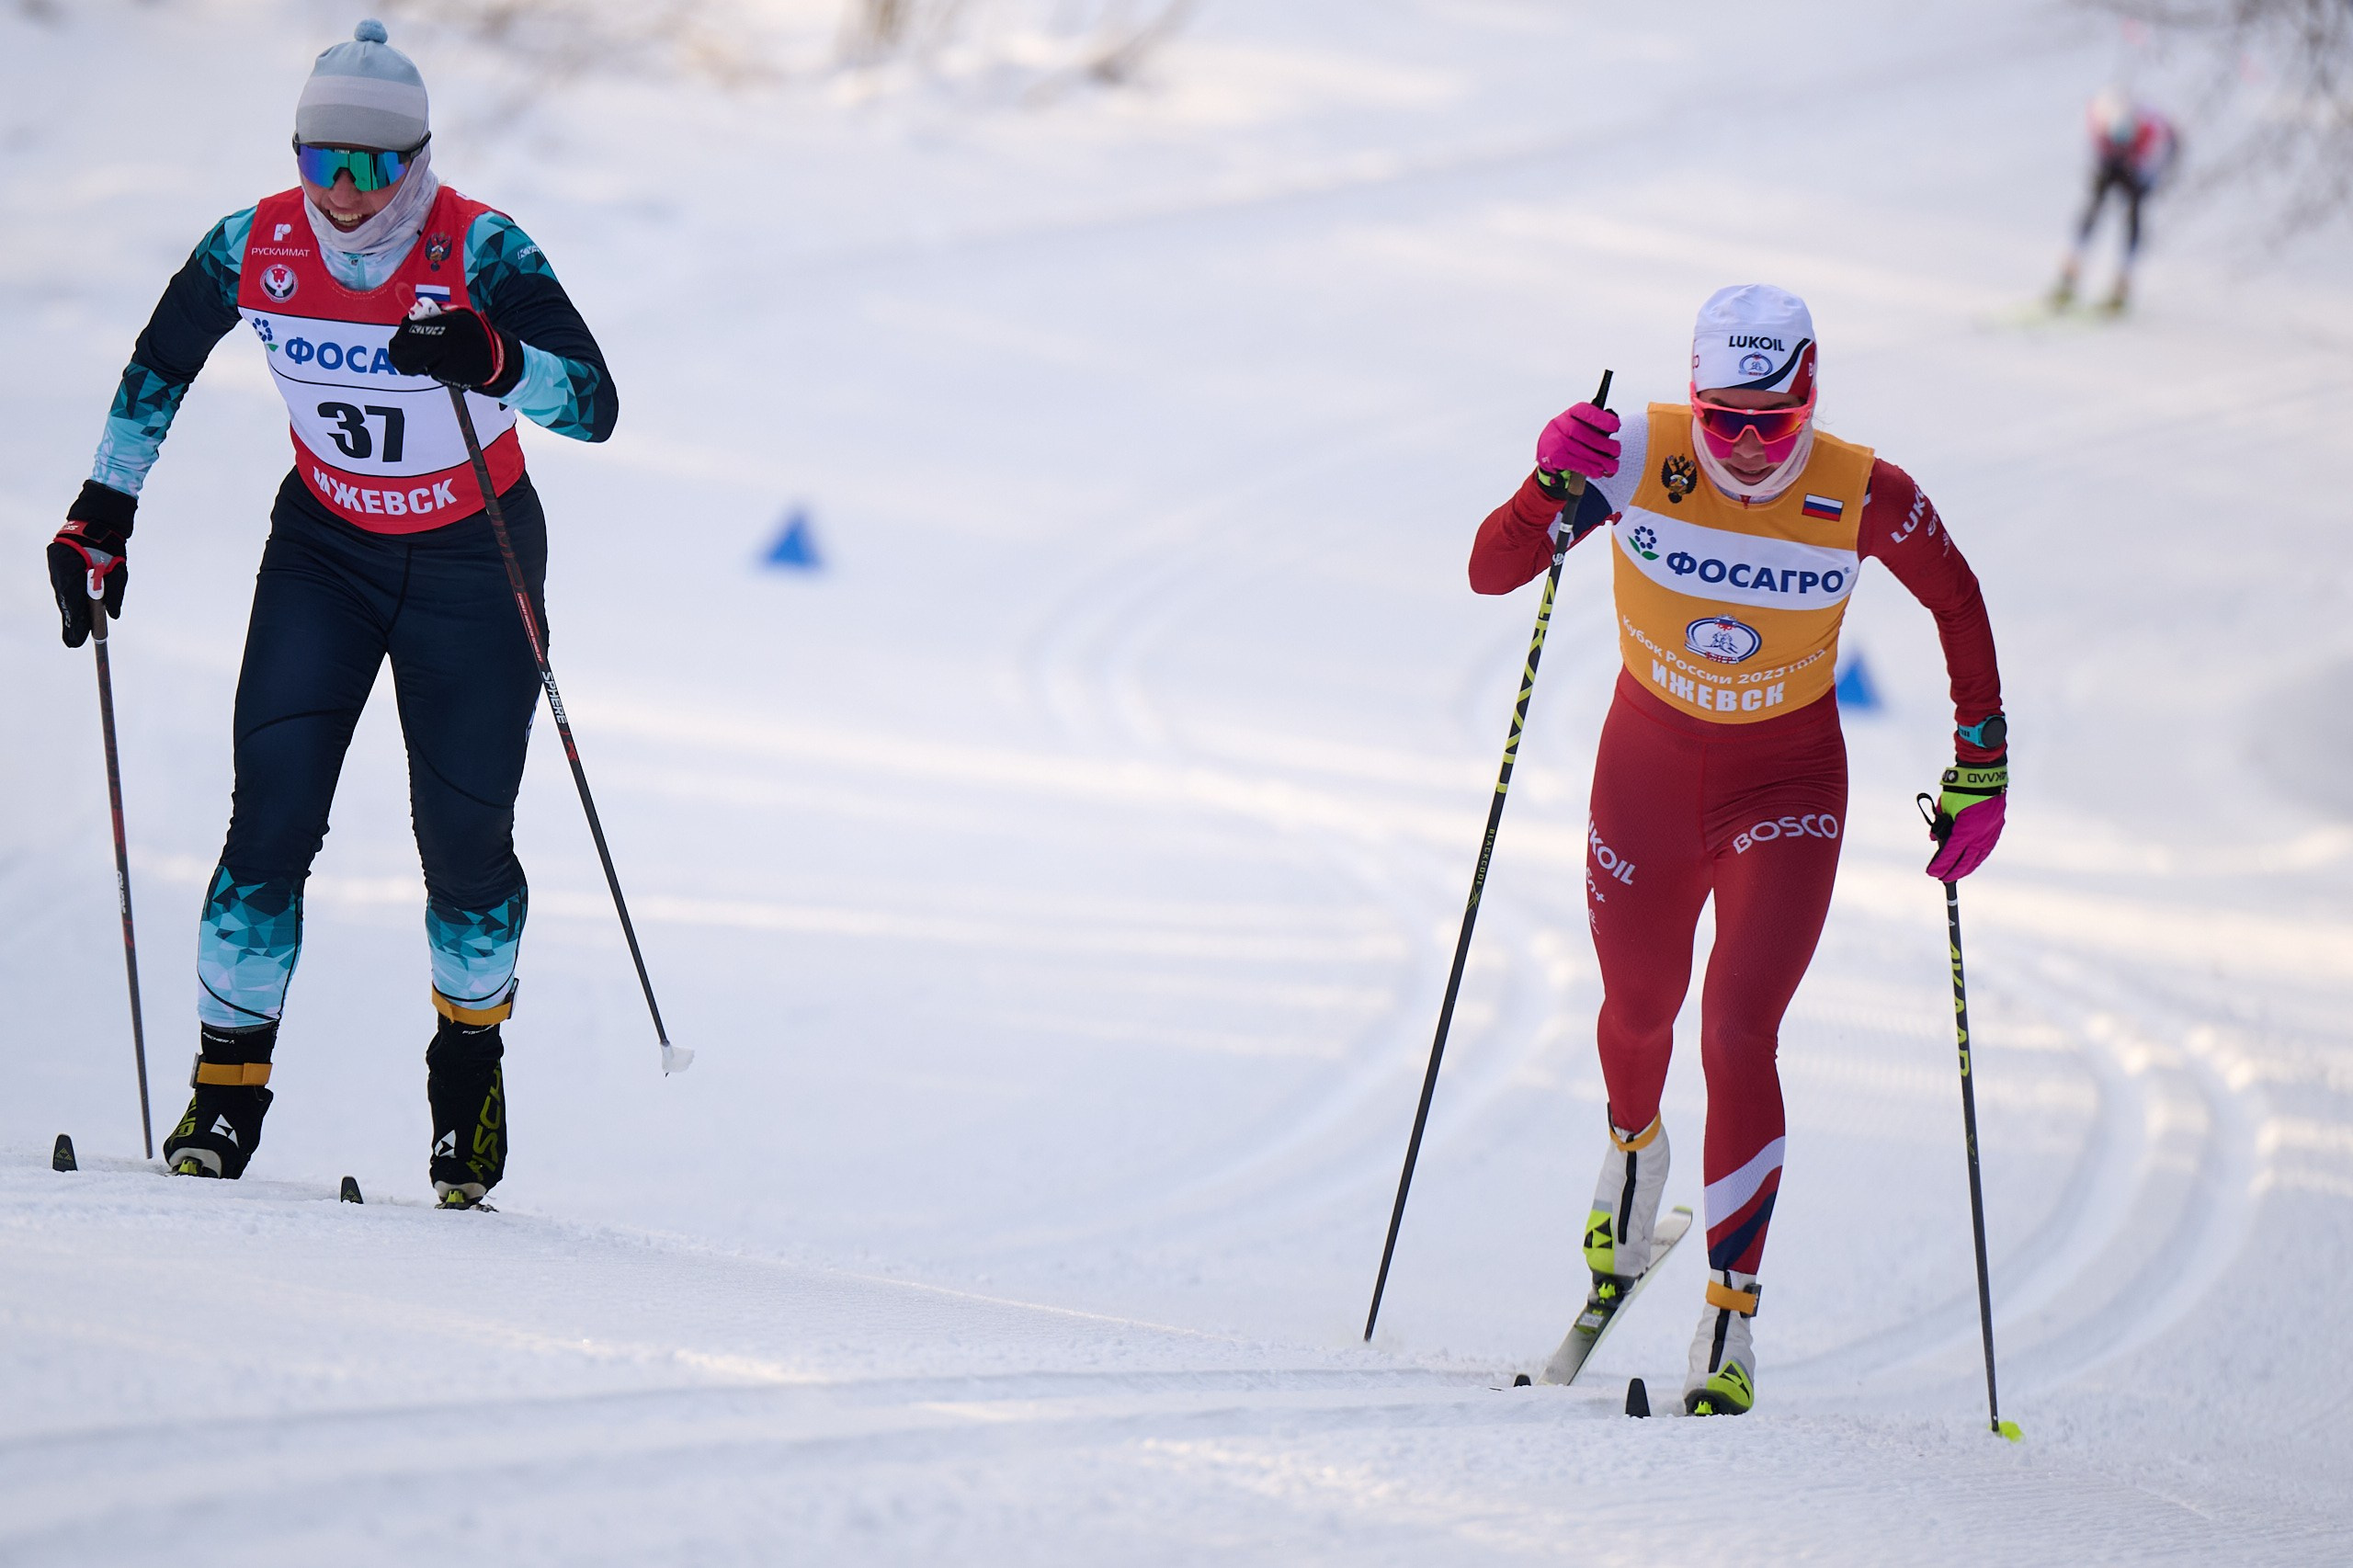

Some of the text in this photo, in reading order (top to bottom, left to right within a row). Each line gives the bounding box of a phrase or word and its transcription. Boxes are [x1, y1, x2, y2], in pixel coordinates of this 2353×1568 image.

[251, 247, 311, 257] РУСКЛИМАТ
[285, 336, 398, 375] ФОСА
[1728, 335, 1785, 352] LUKOIL
[317, 402, 405, 462] 37
[313, 466, 458, 516] ИЖЕВСК
[1890, 482, 1927, 544] LUK
[1665, 551, 1844, 594] ФОСАГРО
[1622, 614, 1664, 659] Кубок
[1665, 650, 1733, 685] России
[541, 670, 568, 724] SPHERE
[1651, 659, 1786, 712] ИЖЕВСК
[1476, 827, 1495, 887] BLACKCODE
[1588, 810, 1636, 886] KOIL
[1732, 813, 1838, 855] BOSCO
